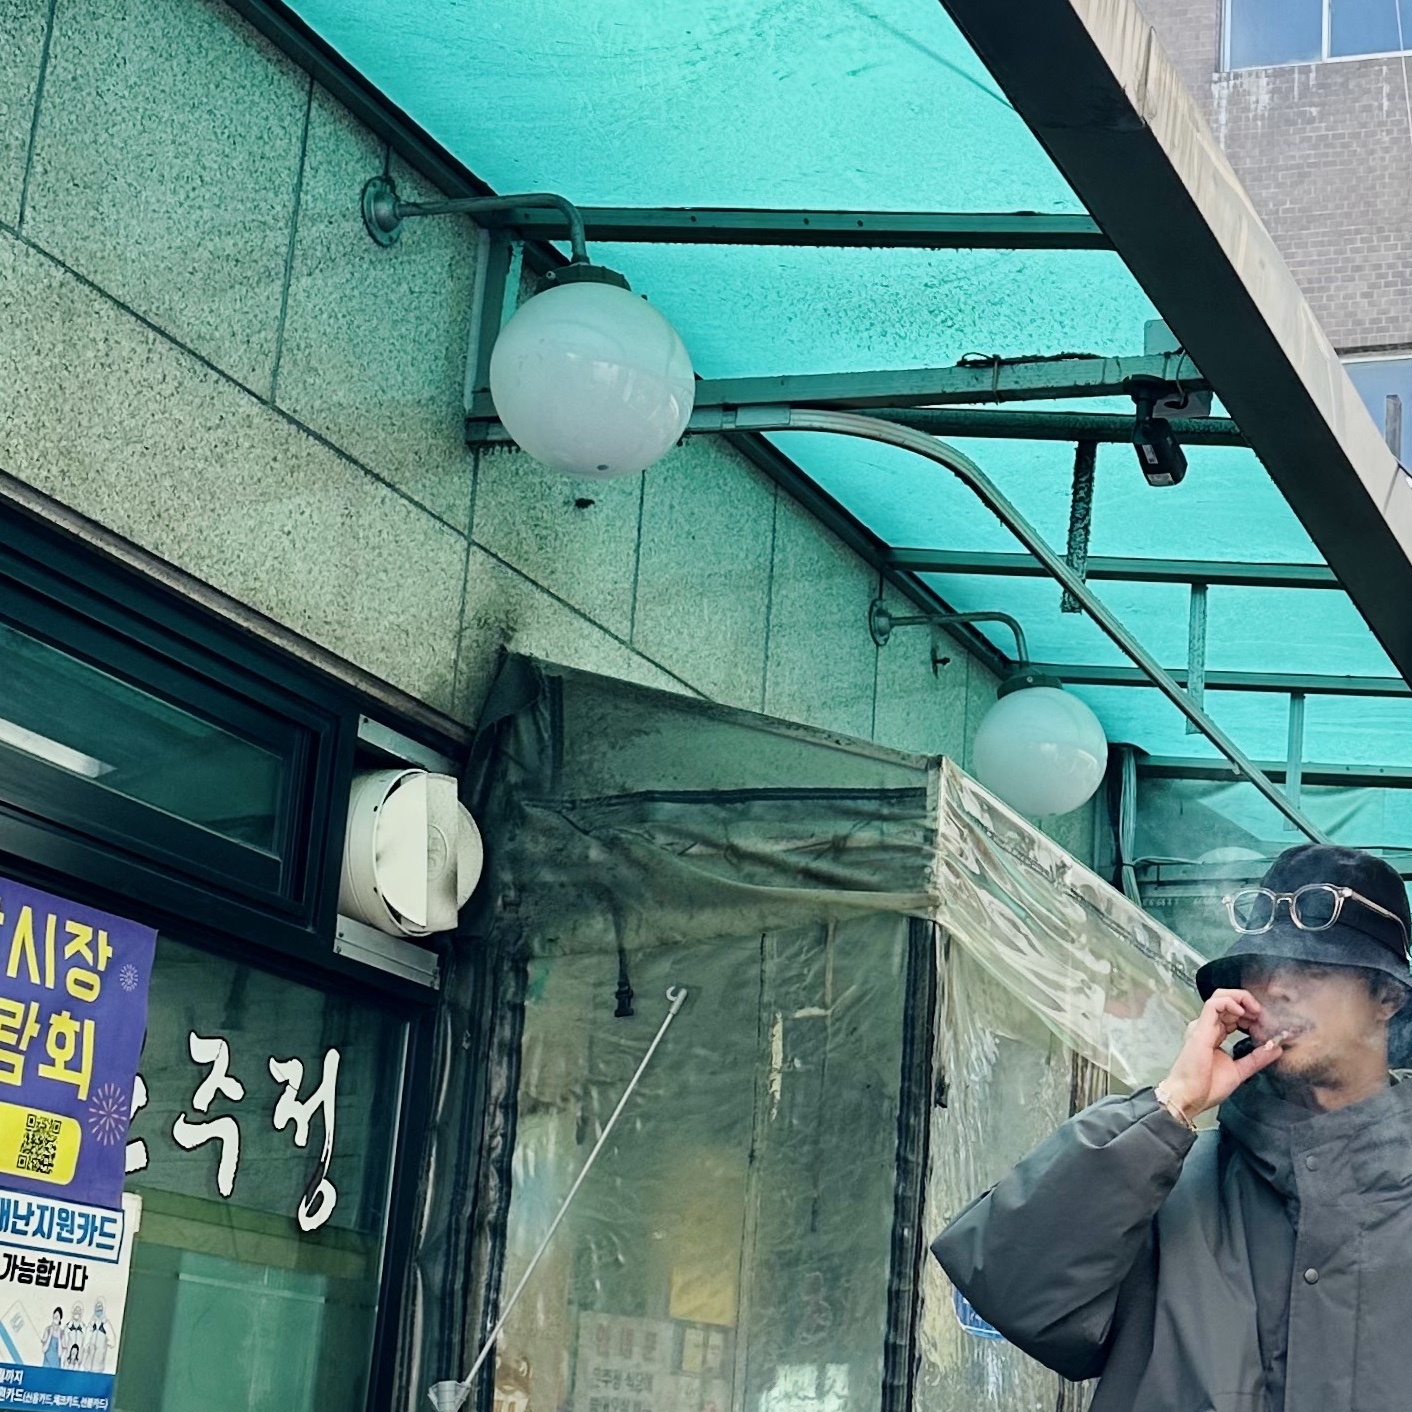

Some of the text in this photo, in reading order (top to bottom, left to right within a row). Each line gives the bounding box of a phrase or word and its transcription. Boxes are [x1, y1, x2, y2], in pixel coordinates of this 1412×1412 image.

[0, 898, 113, 1003] 시장
[125, 1031, 341, 1232] 주정
[0, 1253, 88, 1291] 가능합니다
